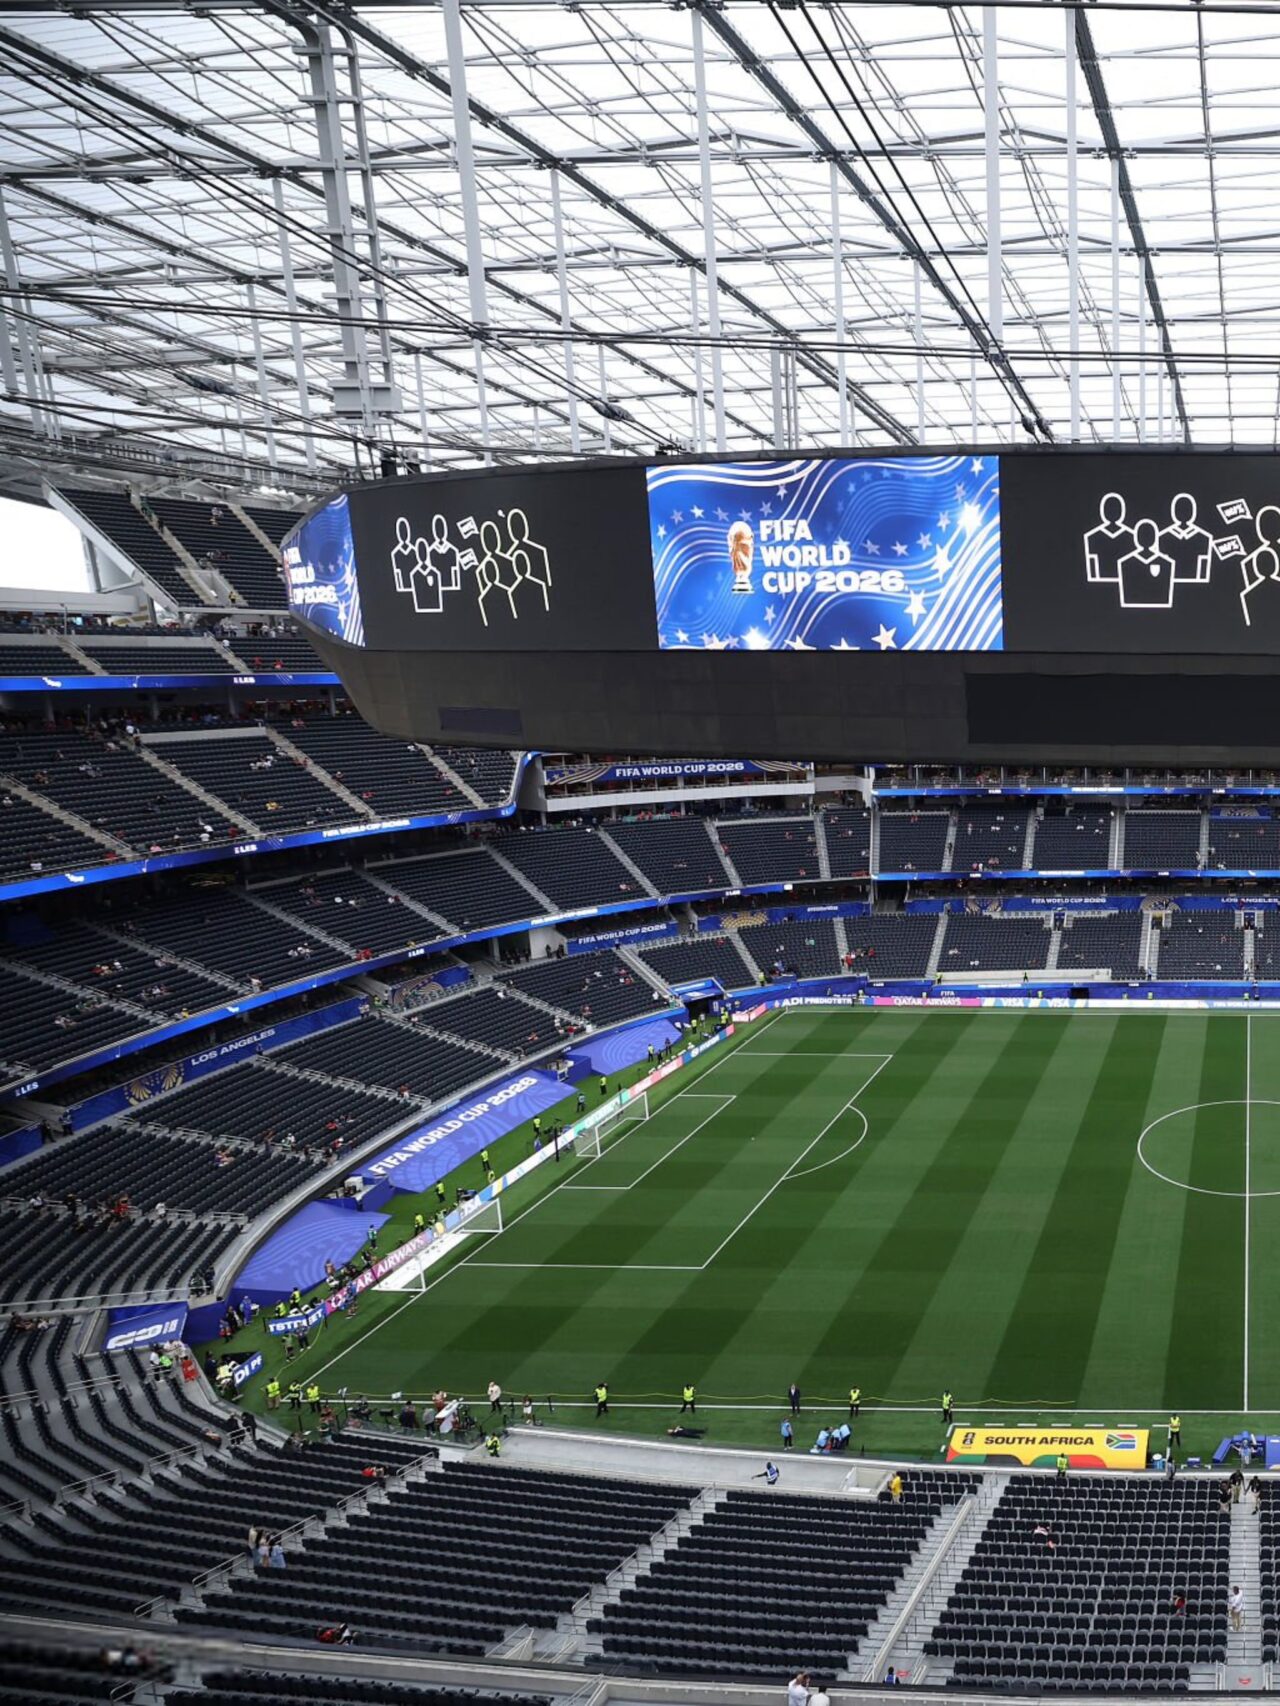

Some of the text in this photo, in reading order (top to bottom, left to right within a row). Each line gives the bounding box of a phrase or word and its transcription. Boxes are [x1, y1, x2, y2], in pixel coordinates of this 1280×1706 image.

[760, 519, 813, 541] FIFA
[761, 544, 851, 567] WORLD
[762, 570, 906, 593] CUP 2026
[615, 762, 745, 777] FIFA WORLD CUP 2026
[578, 923, 667, 945] FIFA WORLD CUP 2026
[893, 997, 962, 1006] QATAR AIRWAYS
[191, 1029, 276, 1066] LOS ANGELES
[368, 1076, 538, 1176] FIFA WORLD CUP 2026
[331, 1236, 425, 1309] QAR AIRWAYS
[984, 1437, 1036, 1446] SOUTH
[1038, 1437, 1094, 1446] AFRICA
